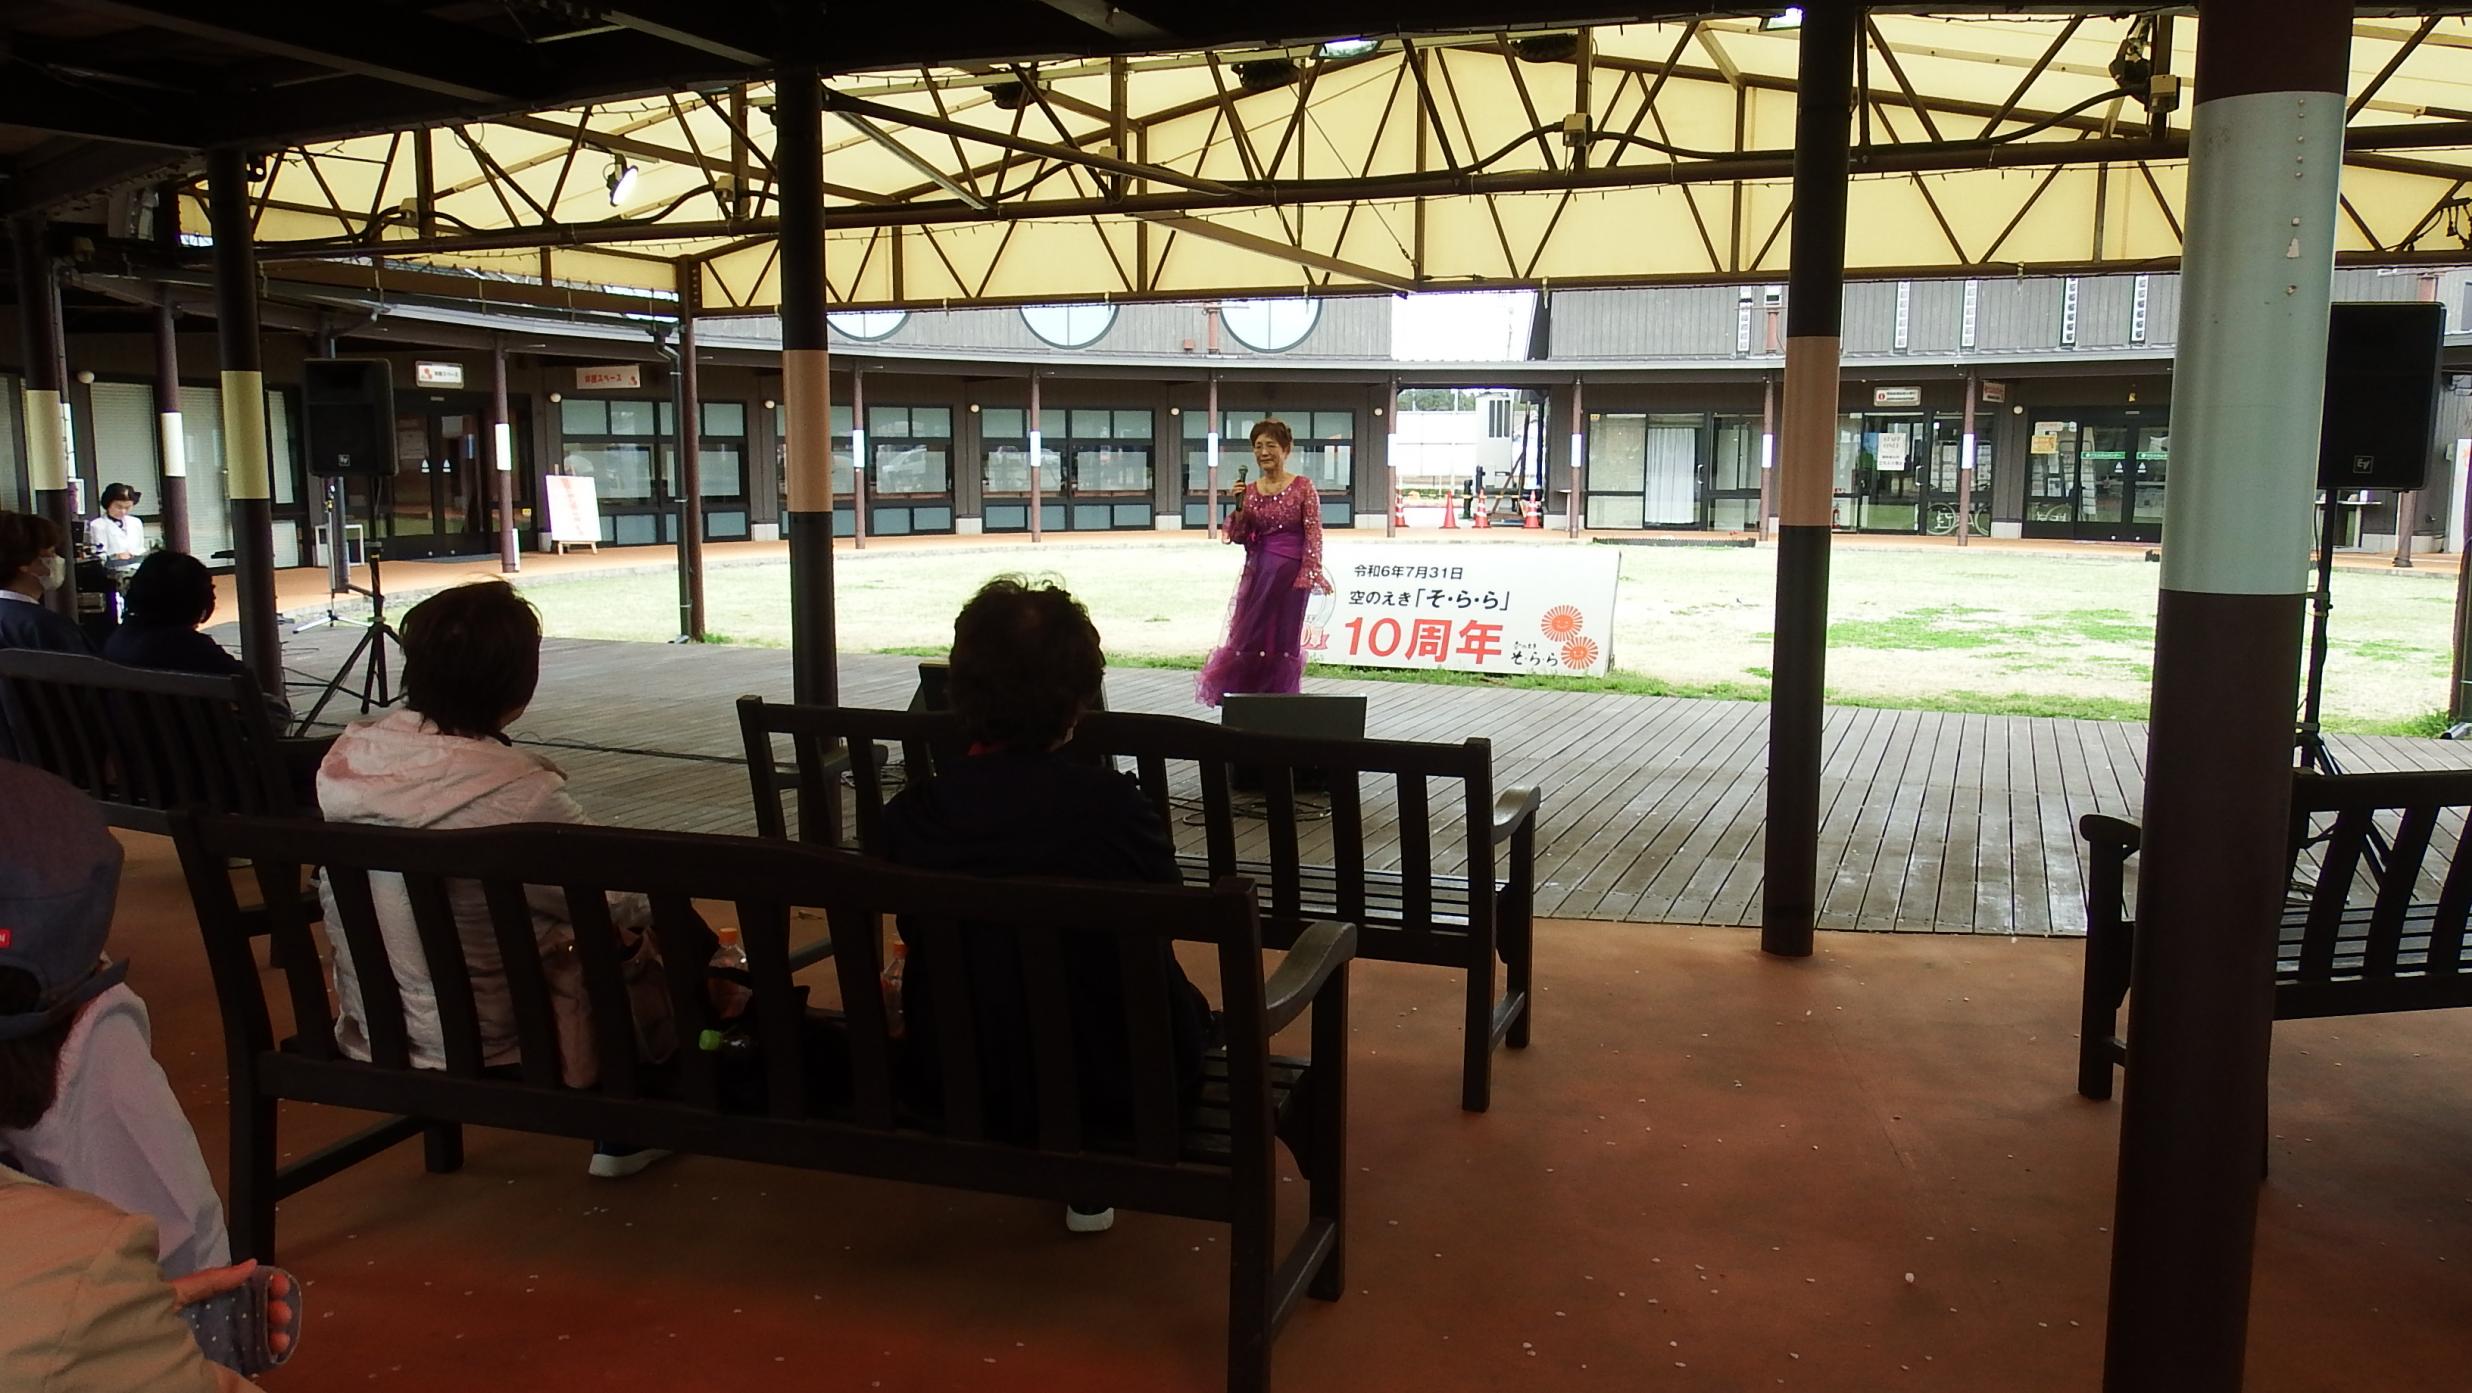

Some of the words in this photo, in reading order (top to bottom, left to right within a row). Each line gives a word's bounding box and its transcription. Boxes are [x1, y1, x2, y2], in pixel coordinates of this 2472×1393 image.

[1353, 564, 1463, 580] 令和6年7月31日
[1344, 617, 1504, 665] 10周年
